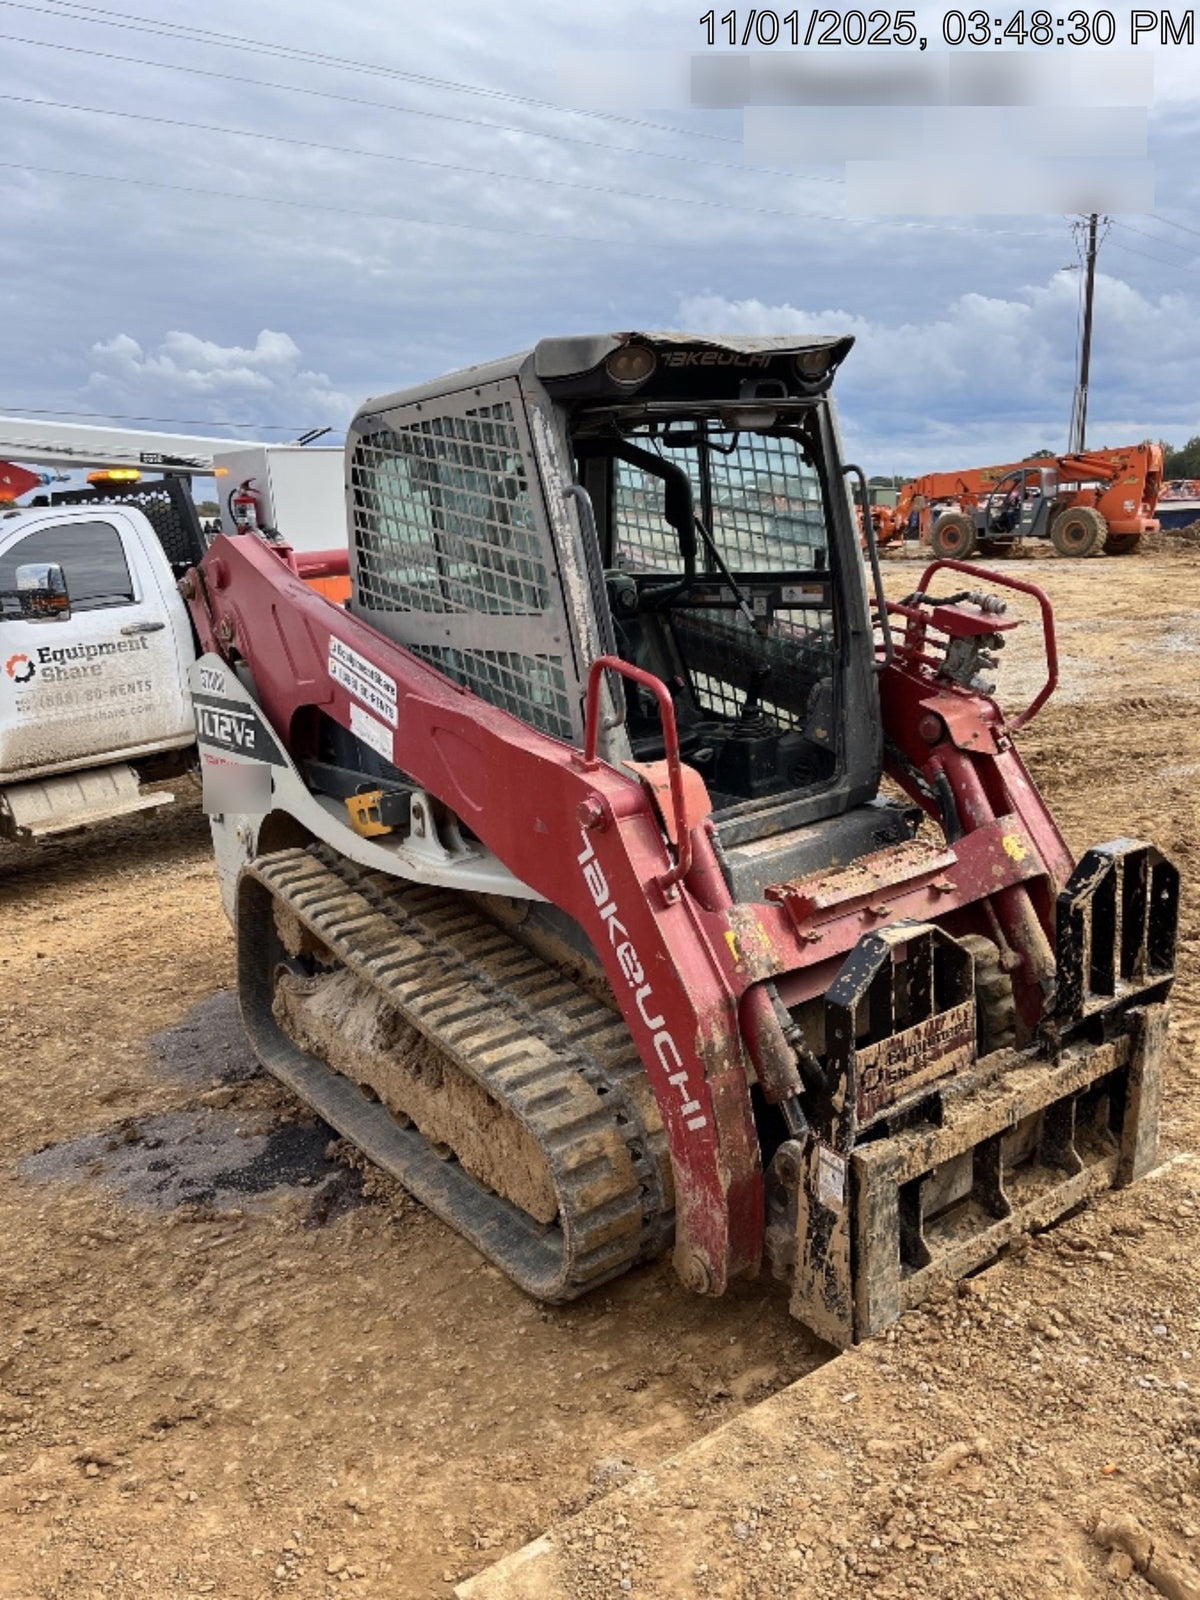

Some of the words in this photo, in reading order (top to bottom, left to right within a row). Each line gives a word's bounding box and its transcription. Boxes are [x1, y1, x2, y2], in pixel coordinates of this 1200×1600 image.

[37, 636, 149, 666] Equipment
[41, 663, 103, 683] Share
[577, 826, 707, 1132] TAKEUCHI
